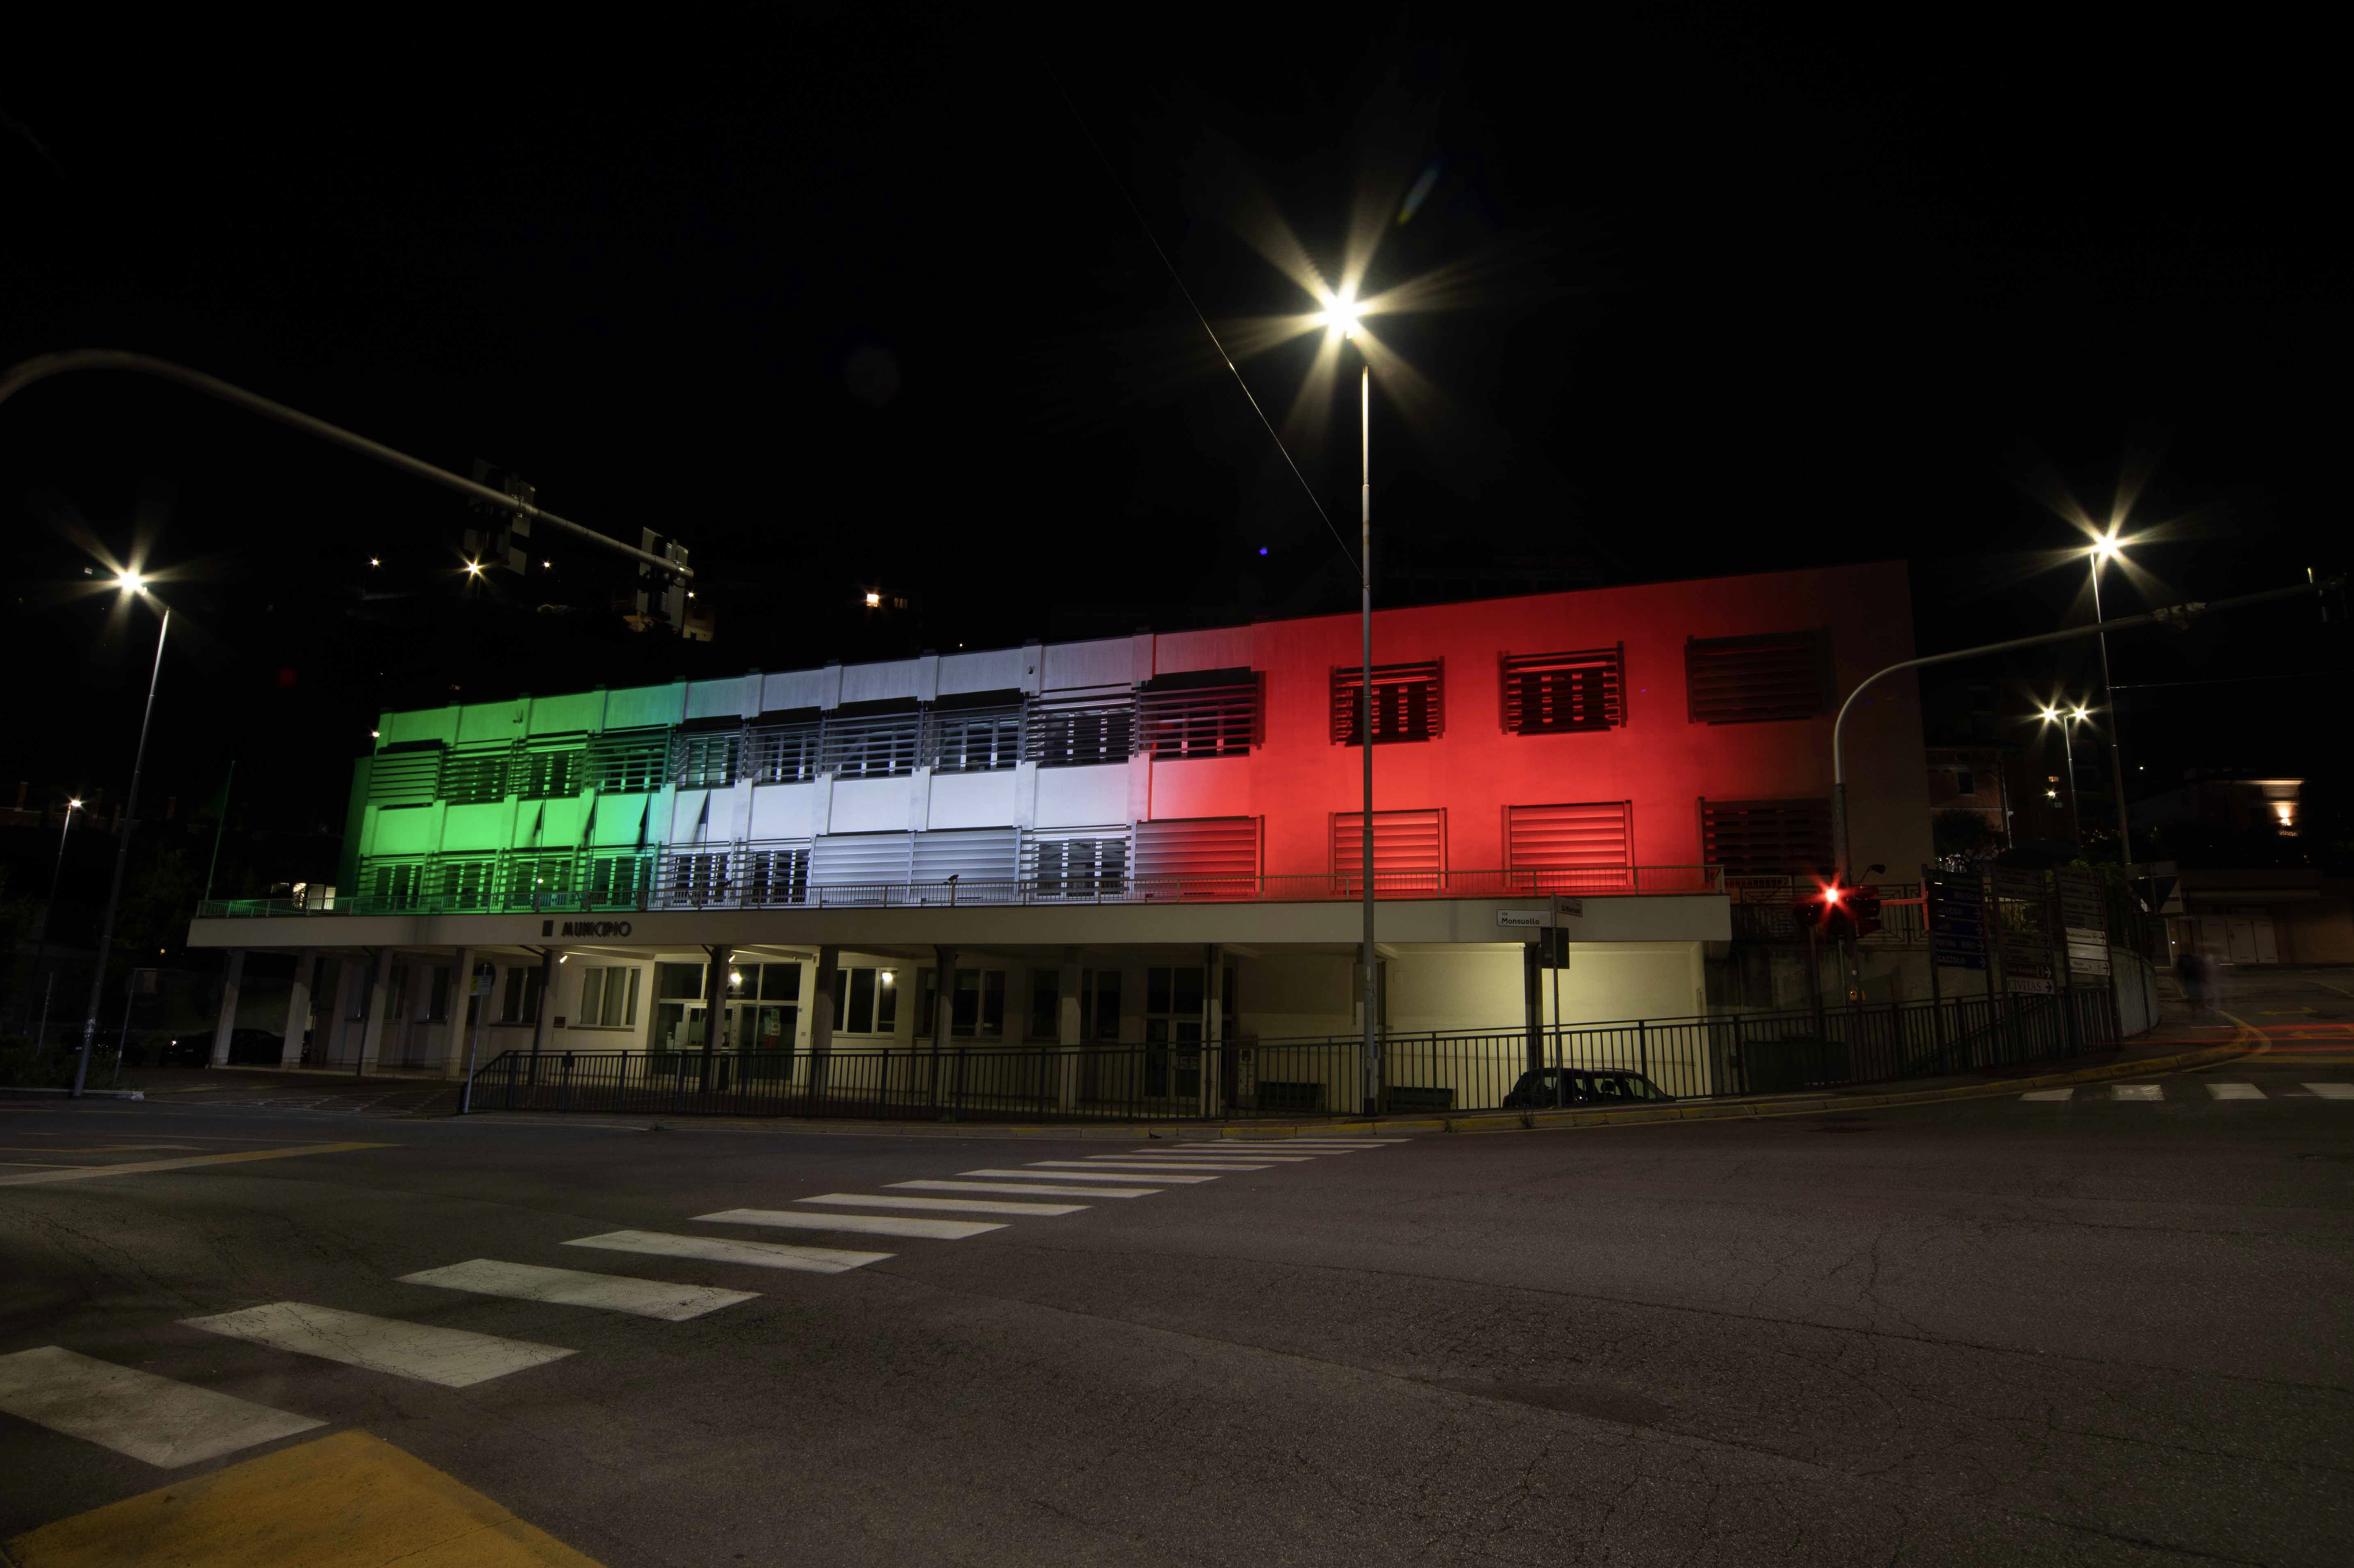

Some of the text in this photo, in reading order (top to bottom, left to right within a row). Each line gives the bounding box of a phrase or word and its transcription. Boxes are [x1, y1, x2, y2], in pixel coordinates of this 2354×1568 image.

[561, 921, 632, 938] MUNICIPIO
[1938, 955, 1966, 964] GAZZOLO
[2008, 979, 2041, 991] CIVITAS
